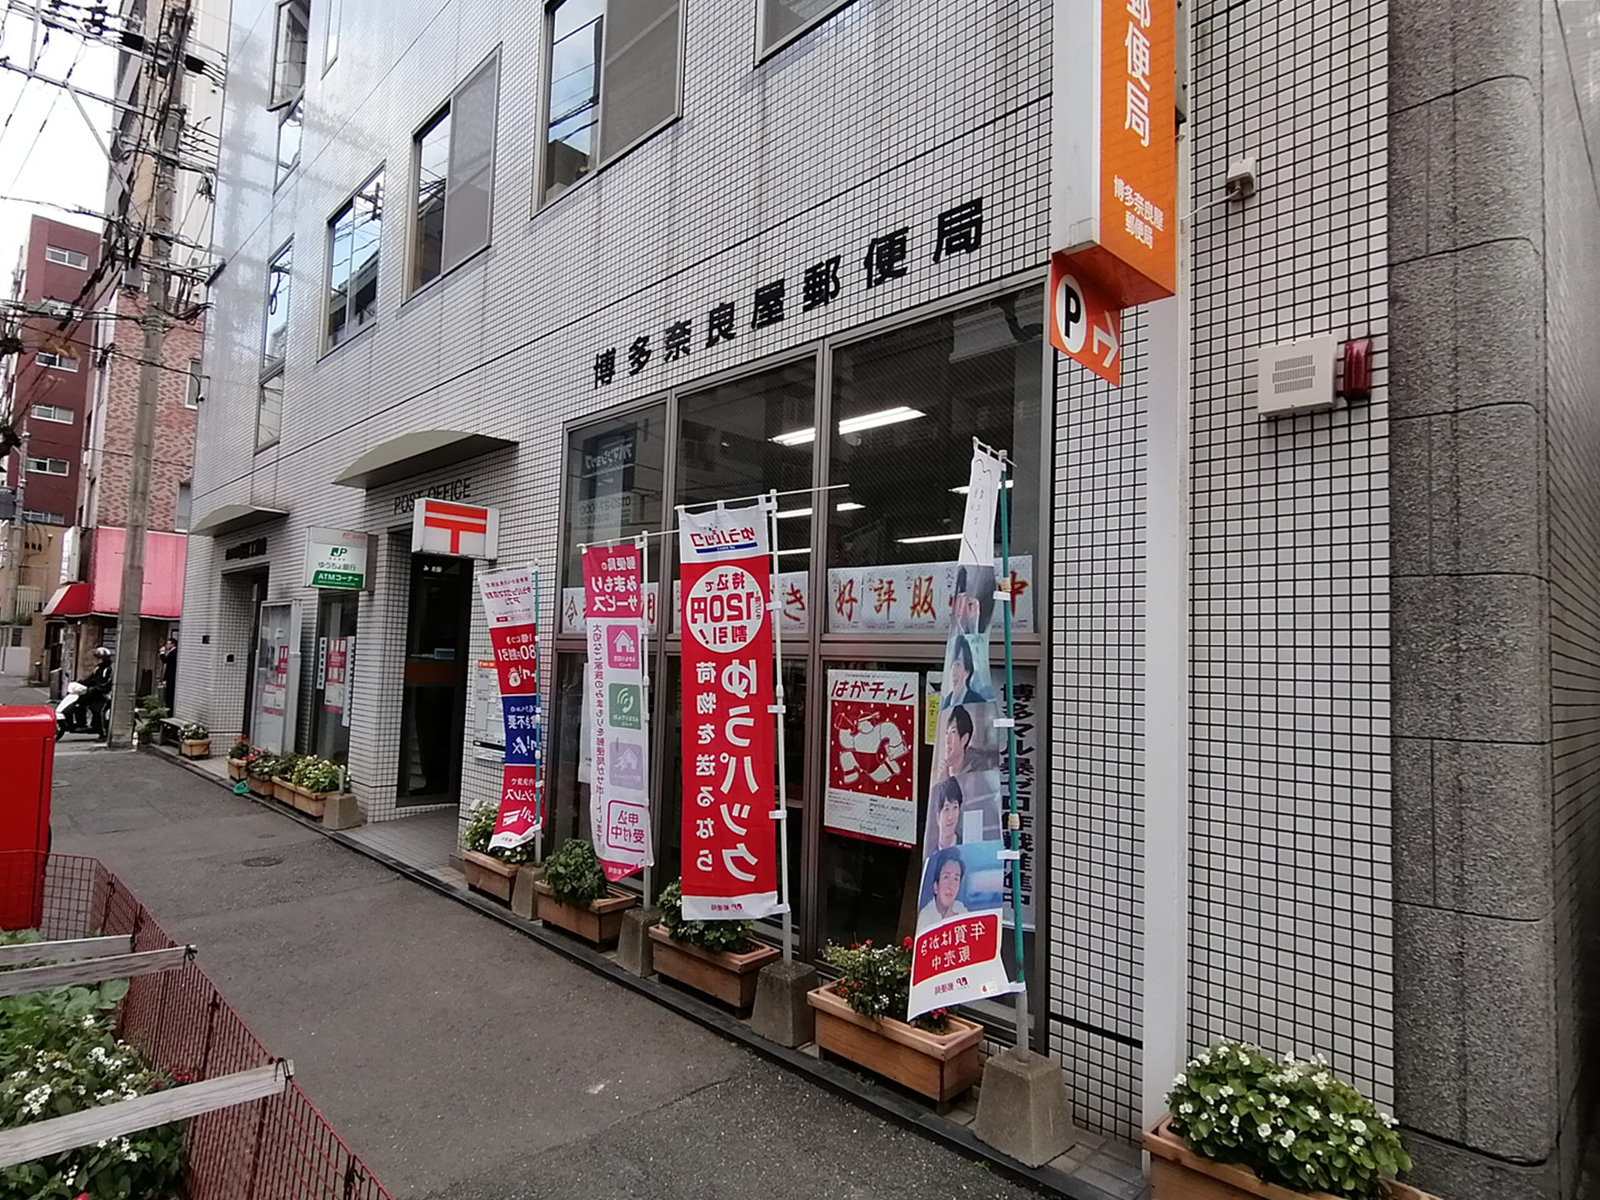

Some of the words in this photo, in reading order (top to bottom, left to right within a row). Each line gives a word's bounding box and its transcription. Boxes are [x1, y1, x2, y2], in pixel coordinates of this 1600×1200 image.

[1113, 175, 1164, 232] 博多奈良屋
[1125, 211, 1154, 250] 郵便局
[593, 197, 984, 389] 博多奈良屋郵便局
[1064, 283, 1081, 338] P
[428, 477, 472, 502] OFFICE
[318, 561, 356, 571] ゆうちょ銀行
[318, 573, 359, 582] ATMコーナー
[831, 680, 914, 700] はがチャレ
